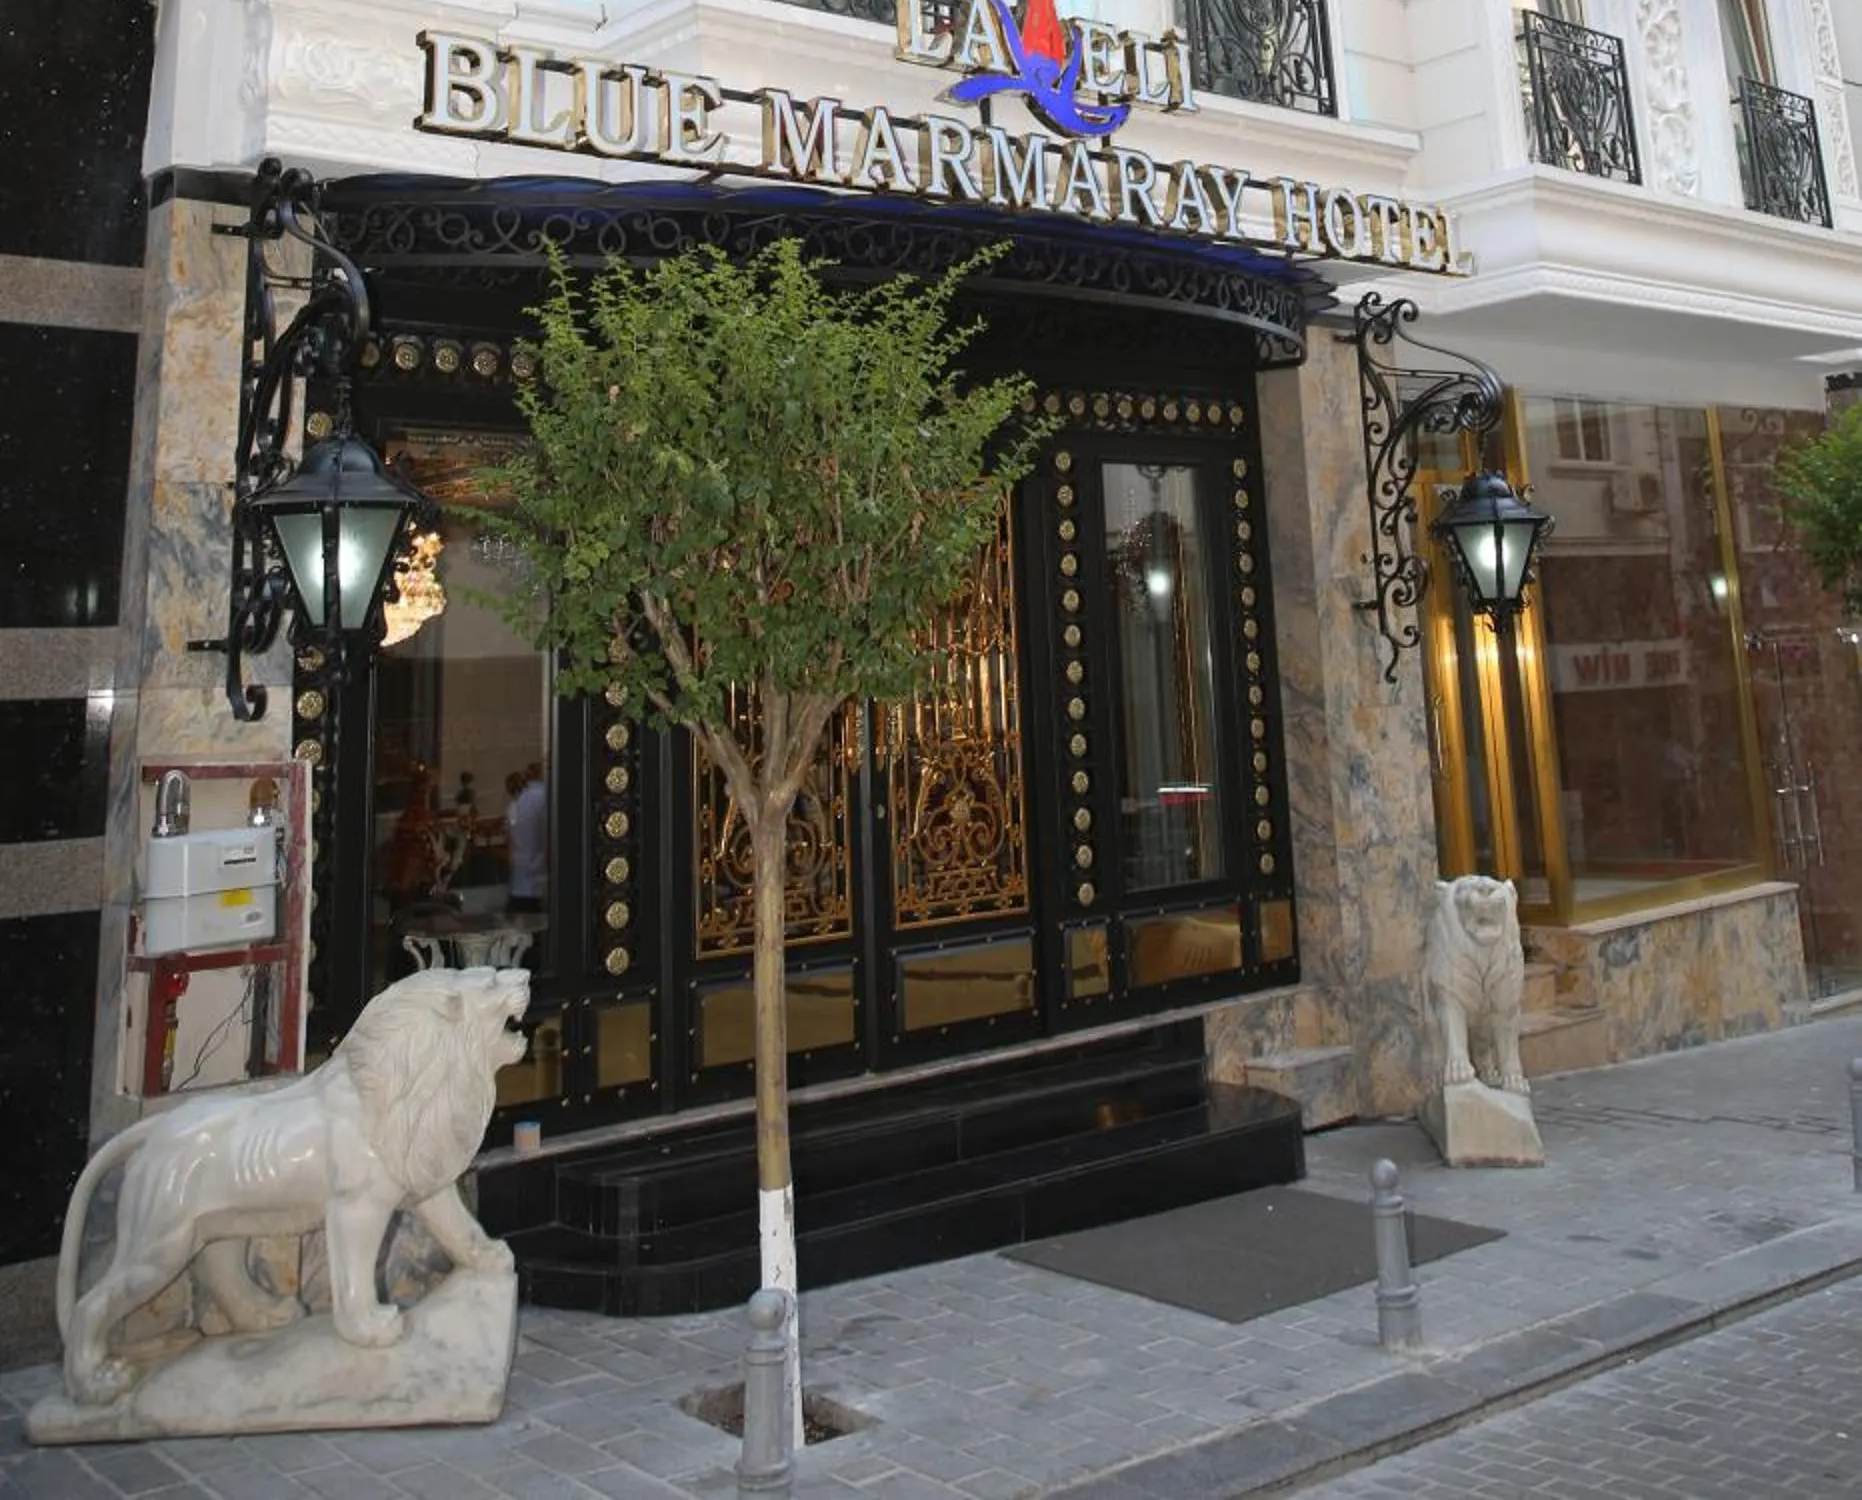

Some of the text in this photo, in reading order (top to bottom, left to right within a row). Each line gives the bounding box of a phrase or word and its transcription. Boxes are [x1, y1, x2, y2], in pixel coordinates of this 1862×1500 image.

[415, 30, 1475, 277] BLUE MARMARAY HOTEL
